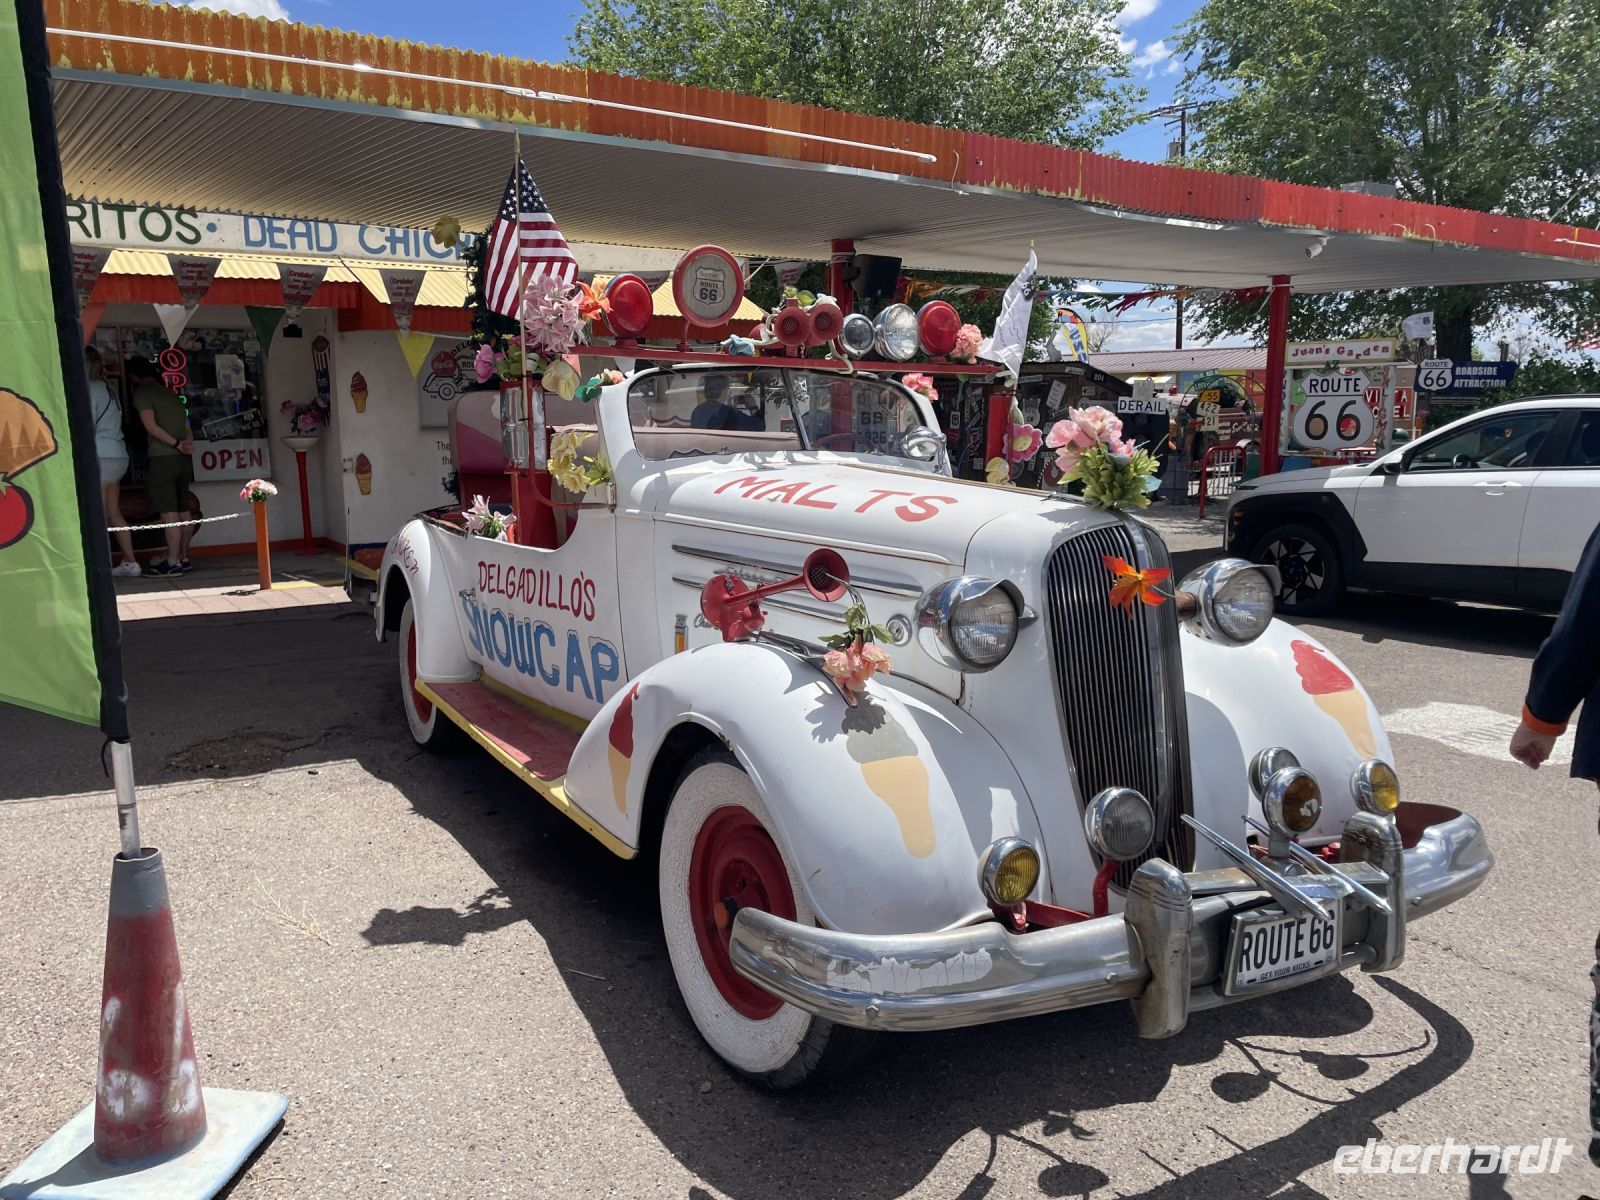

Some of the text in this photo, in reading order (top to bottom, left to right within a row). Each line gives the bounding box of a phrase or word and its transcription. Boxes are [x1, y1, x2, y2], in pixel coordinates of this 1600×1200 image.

[243, 216, 337, 252] DEAD
[700, 281, 720, 289] ROUTE
[699, 288, 718, 301] 66
[1292, 345, 1389, 359] Juan's Garden
[1455, 366, 1497, 376] ROADSIDE
[1309, 378, 1361, 393] ROUTE
[1424, 370, 1446, 387] 66
[1453, 379, 1507, 388] ATTRACTION
[1118, 400, 1165, 413] DERAIL
[1305, 400, 1361, 441] 66
[858, 431, 887, 443] 926
[201, 448, 263, 470] OPEN
[478, 561, 596, 622] DELGADILLO'S
[1239, 910, 1335, 973] ROUTE 66
[1260, 970, 1273, 981] GET
[1274, 967, 1291, 977] YOUR
